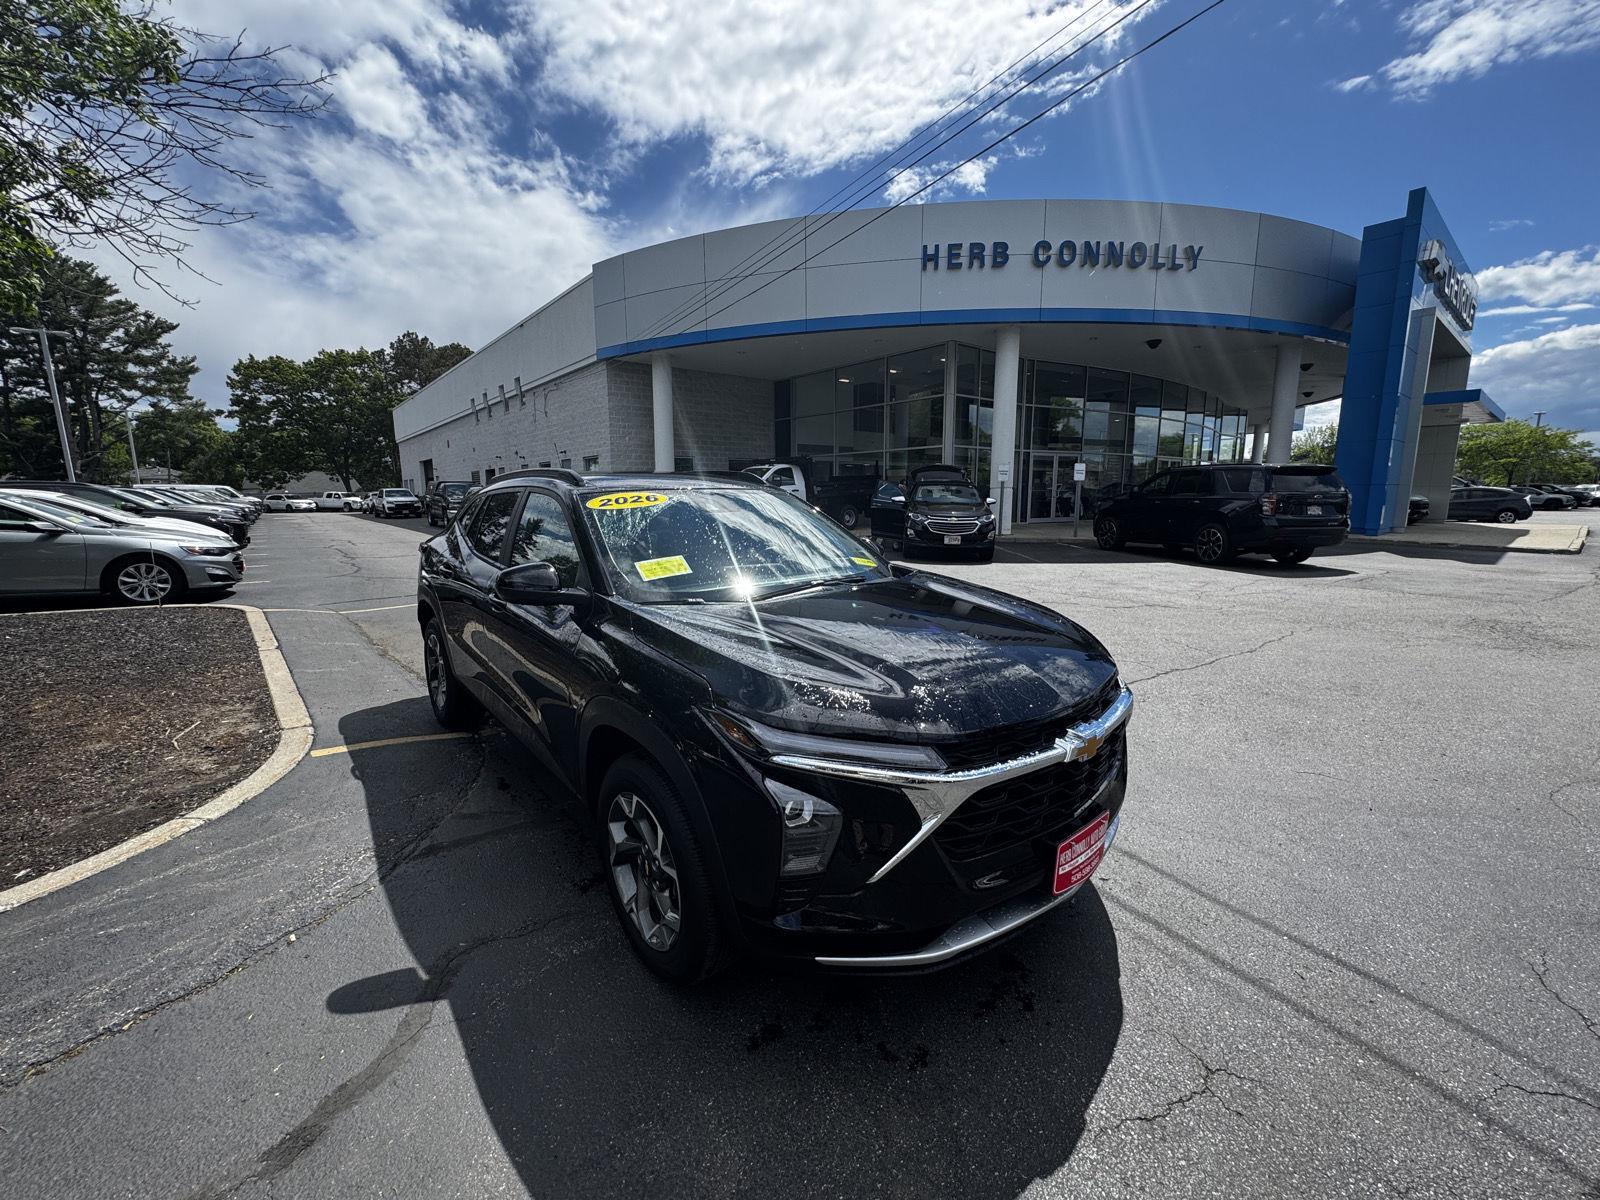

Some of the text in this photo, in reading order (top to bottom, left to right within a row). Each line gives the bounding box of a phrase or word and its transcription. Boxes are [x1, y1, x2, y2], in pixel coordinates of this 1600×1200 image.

[922, 240, 1204, 271] HERB CONNOLLY
[598, 495, 659, 507] 2026
